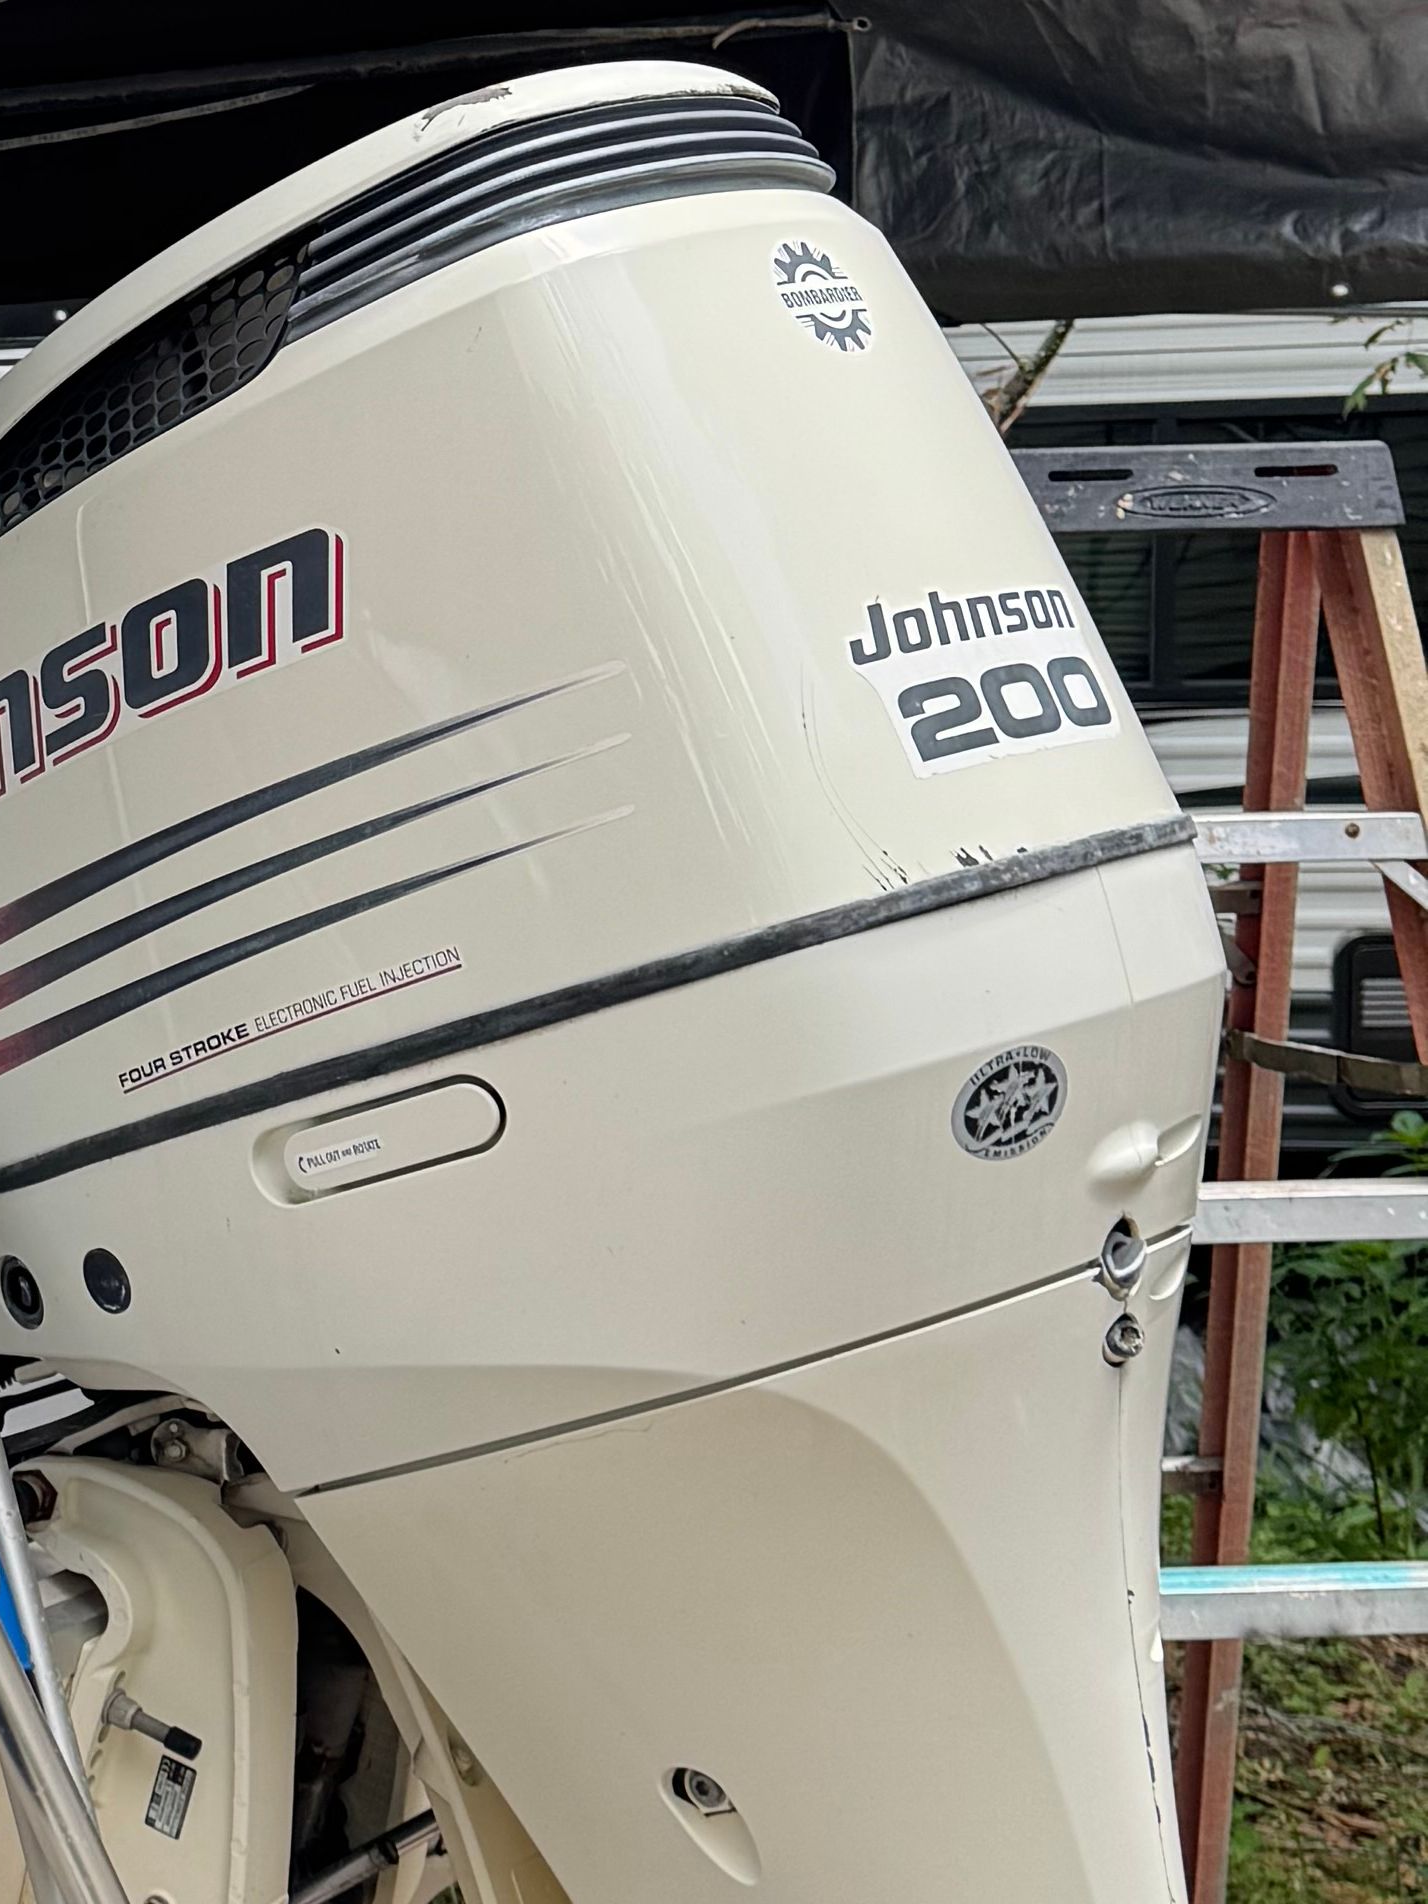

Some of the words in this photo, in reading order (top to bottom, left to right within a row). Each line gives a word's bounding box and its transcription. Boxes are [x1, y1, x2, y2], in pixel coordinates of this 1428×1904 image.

[781, 286, 863, 308] BOMBARDIER
[849, 590, 1075, 665] Johnson
[898, 656, 1112, 762] 200
[118, 1057, 166, 1088] FOUR
[170, 1023, 250, 1066] STROKE
[254, 989, 338, 1032] ELECTRONIC
[340, 977, 377, 1001] FUEL
[379, 946, 461, 987] INJECTION
[307, 1154, 326, 1169] PULL
[326, 1150, 341, 1163] OUT
